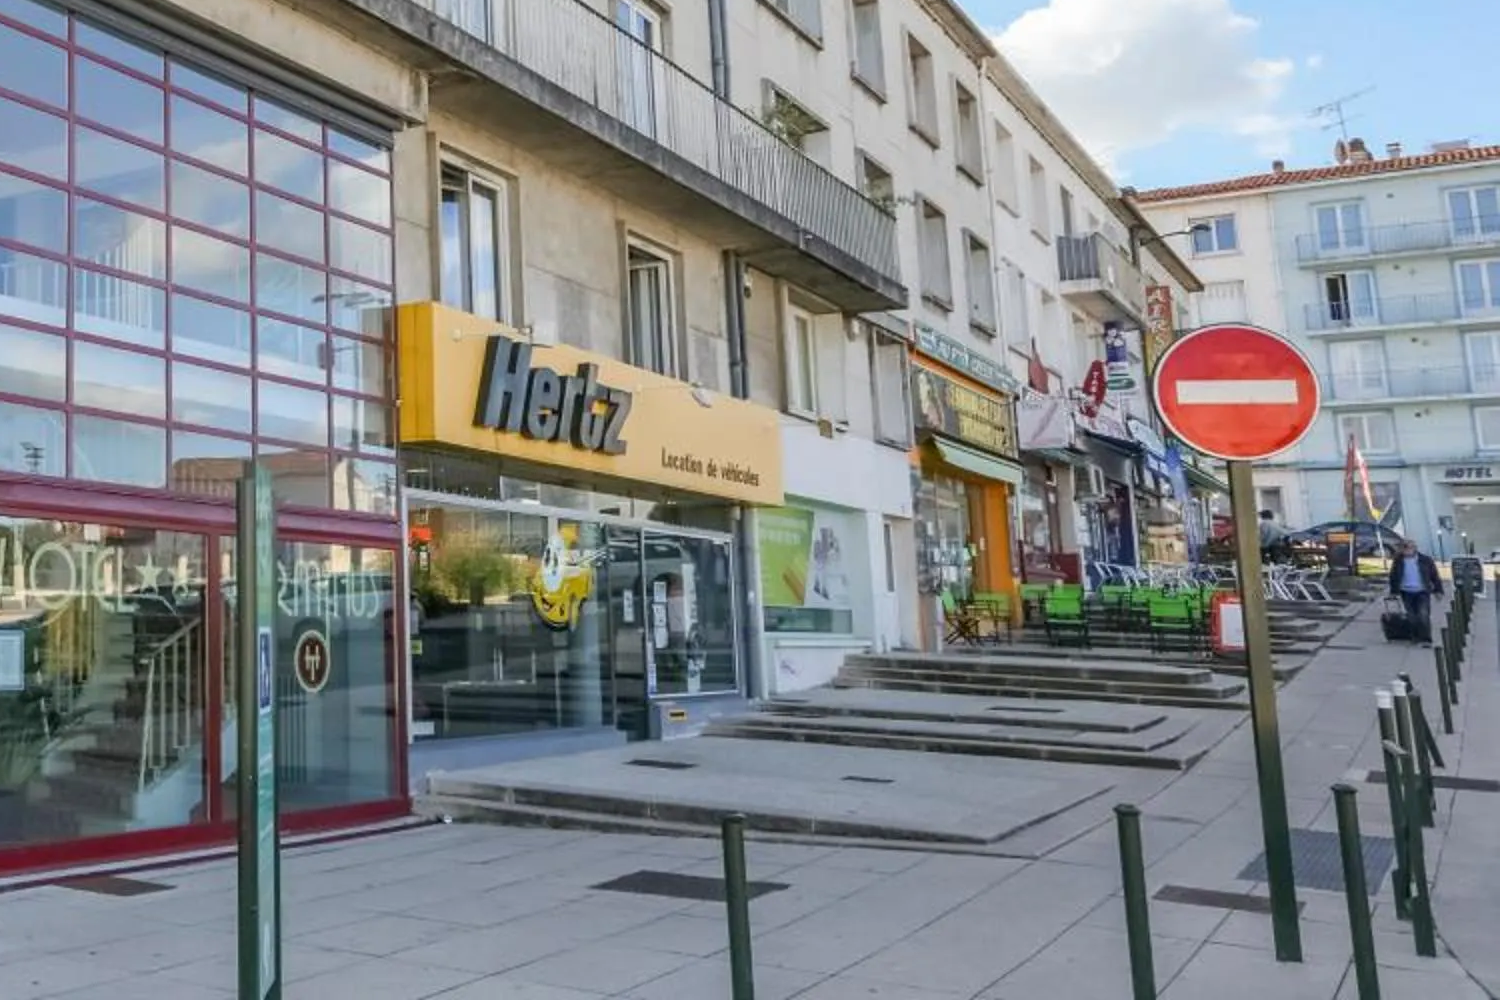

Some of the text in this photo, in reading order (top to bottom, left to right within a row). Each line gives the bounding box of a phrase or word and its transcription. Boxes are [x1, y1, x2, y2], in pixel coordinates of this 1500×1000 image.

[472, 334, 633, 456] Hertz
[661, 446, 703, 475] Location
[706, 459, 717, 478] de
[1444, 466, 1493, 479] HOTEL
